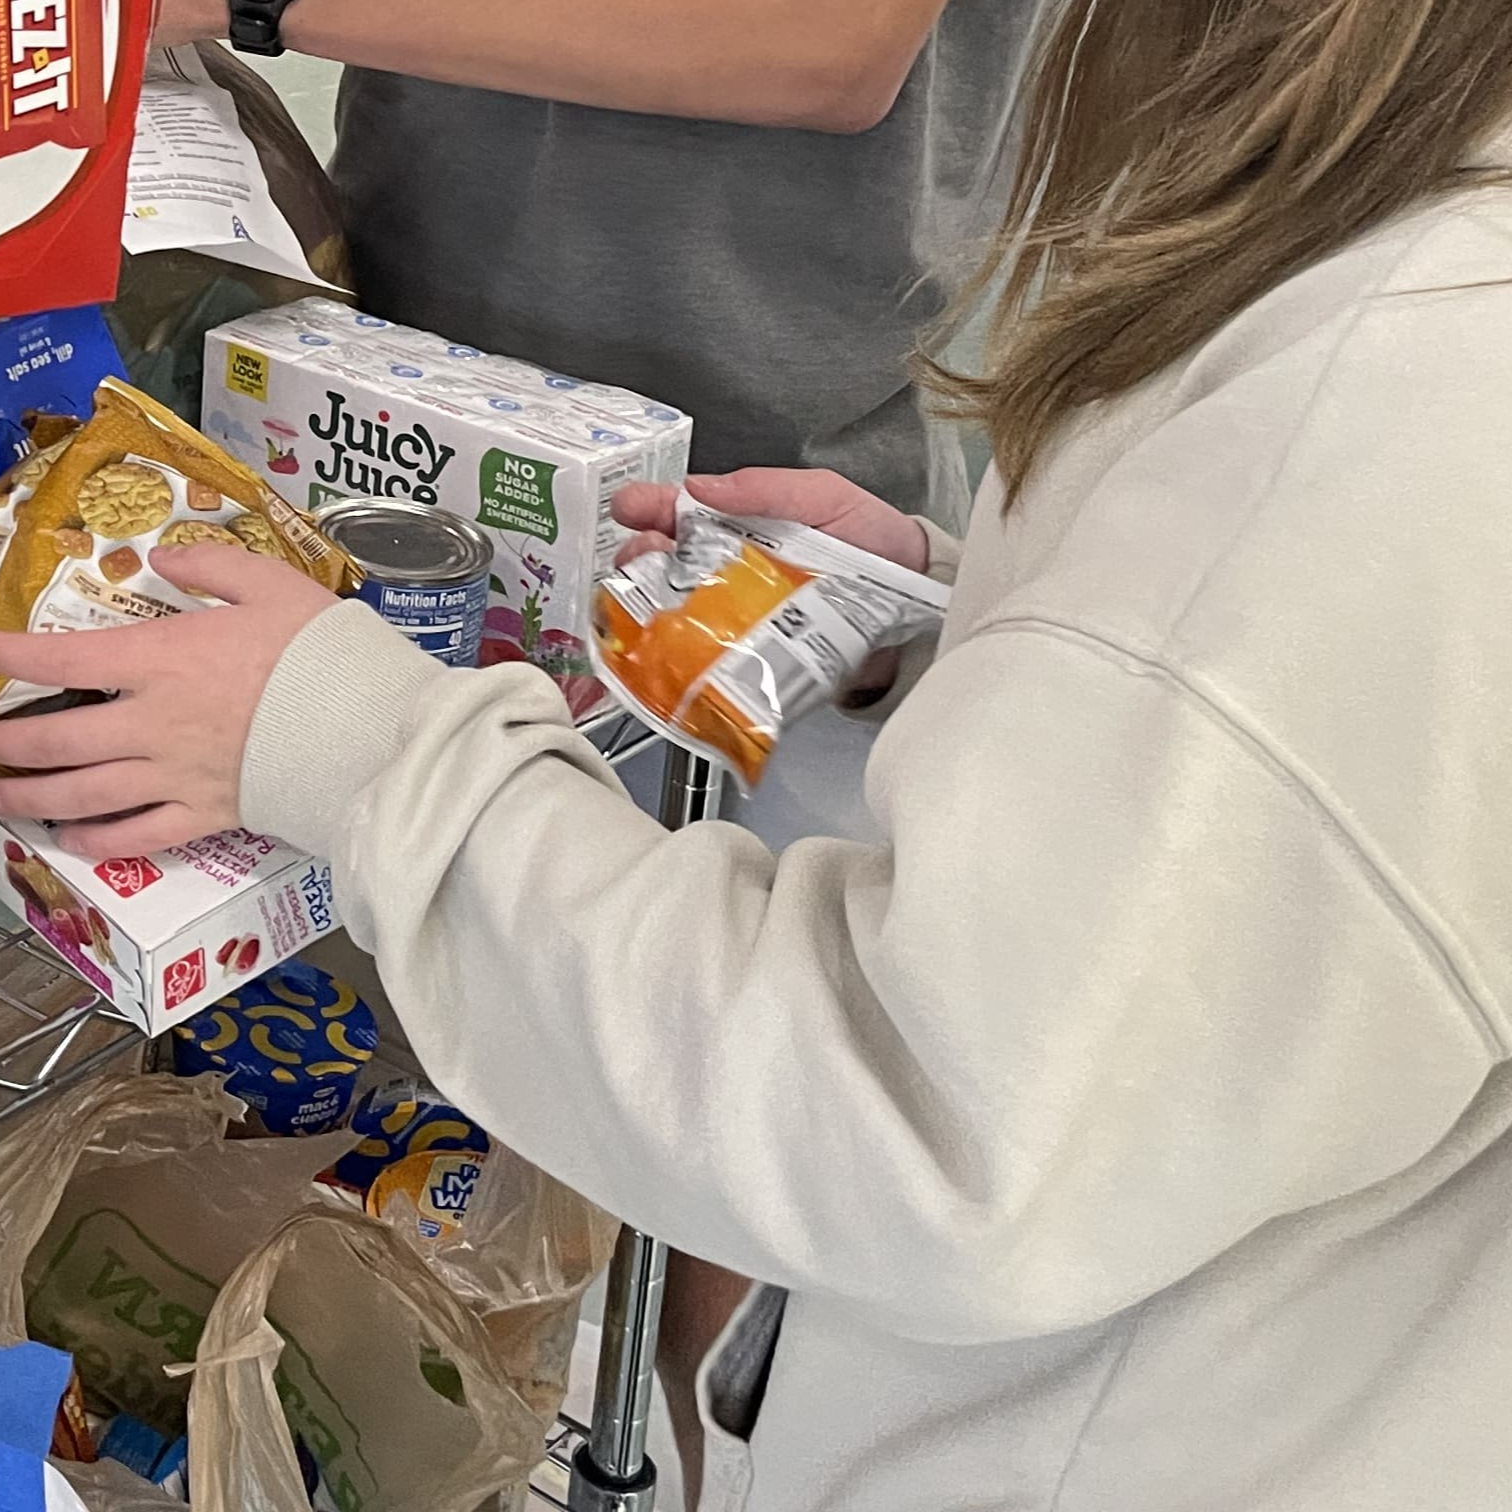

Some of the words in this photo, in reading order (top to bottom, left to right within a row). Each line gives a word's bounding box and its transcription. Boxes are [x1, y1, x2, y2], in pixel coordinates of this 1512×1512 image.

[232, 362, 264, 384] LOOK
[235, 353, 262, 370] NEW
[308, 390, 457, 486] Juicy
[314, 441, 441, 506] Juice
[503, 458, 537, 481] NO
[494, 472, 540, 496] SUGAR
[483, 496, 501, 512] NO
[502, 501, 556, 528] ARTIFICIAL
[486, 508, 552, 538] SWEETENERS
[384, 590, 438, 608] Nutrition
[438, 590, 467, 607] Facts
[299, 864, 332, 933] CEREAL
